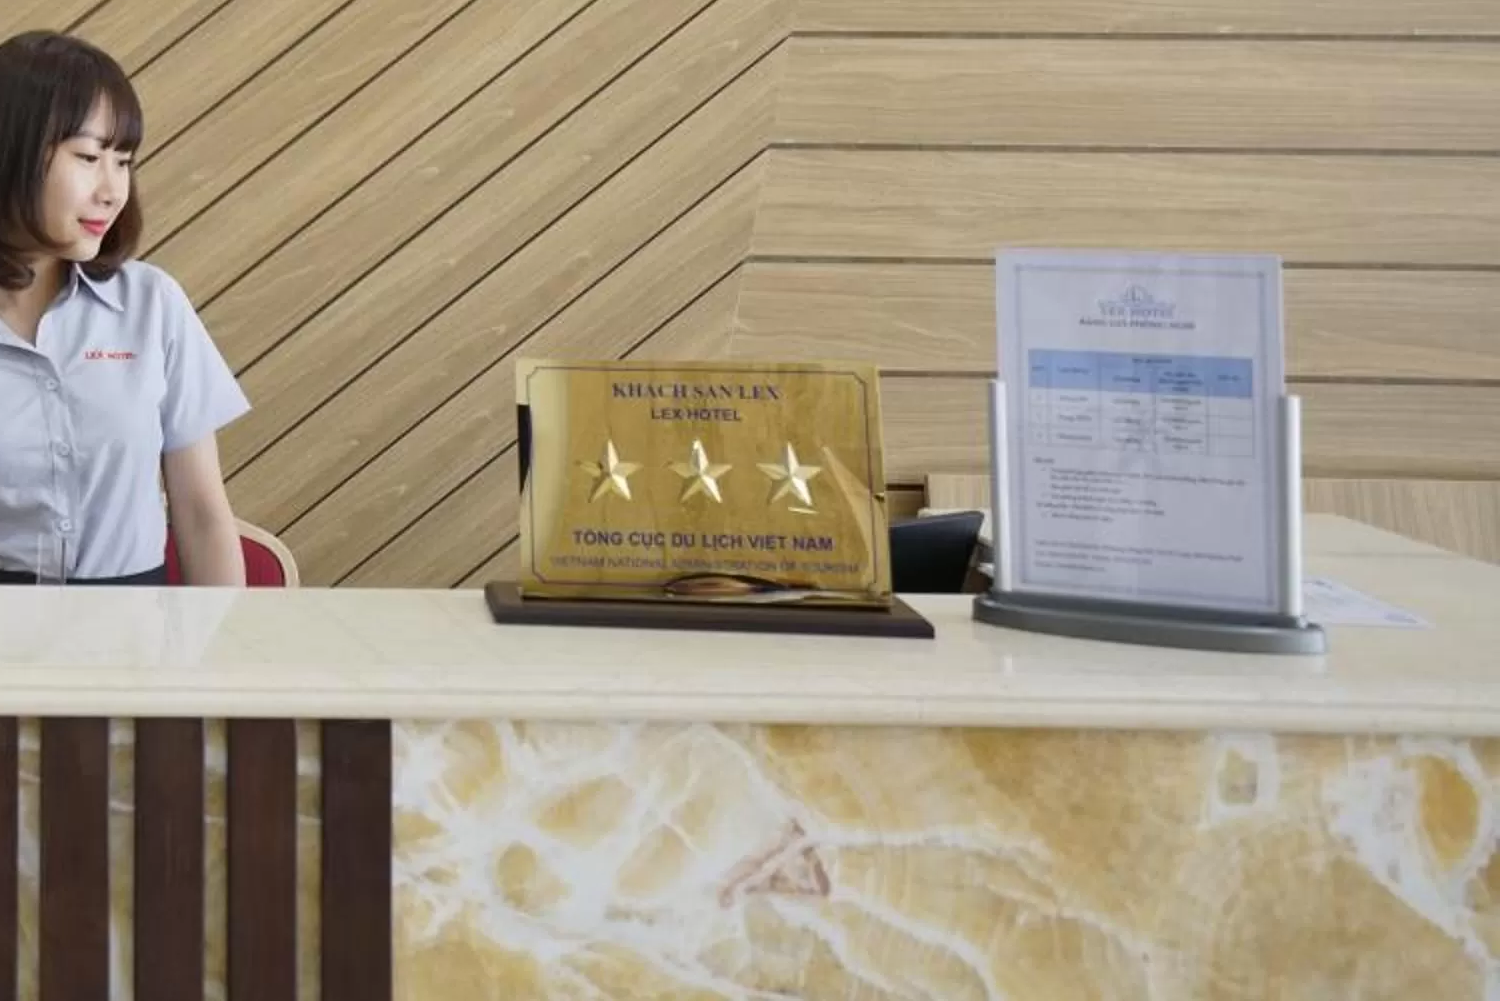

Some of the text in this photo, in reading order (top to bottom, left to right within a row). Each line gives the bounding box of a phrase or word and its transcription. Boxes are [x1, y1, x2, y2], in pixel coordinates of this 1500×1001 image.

[739, 384, 781, 400] LEX
[651, 407, 742, 421] LEX HOTEL
[671, 532, 695, 547] DU
[792, 535, 834, 551] NAM
